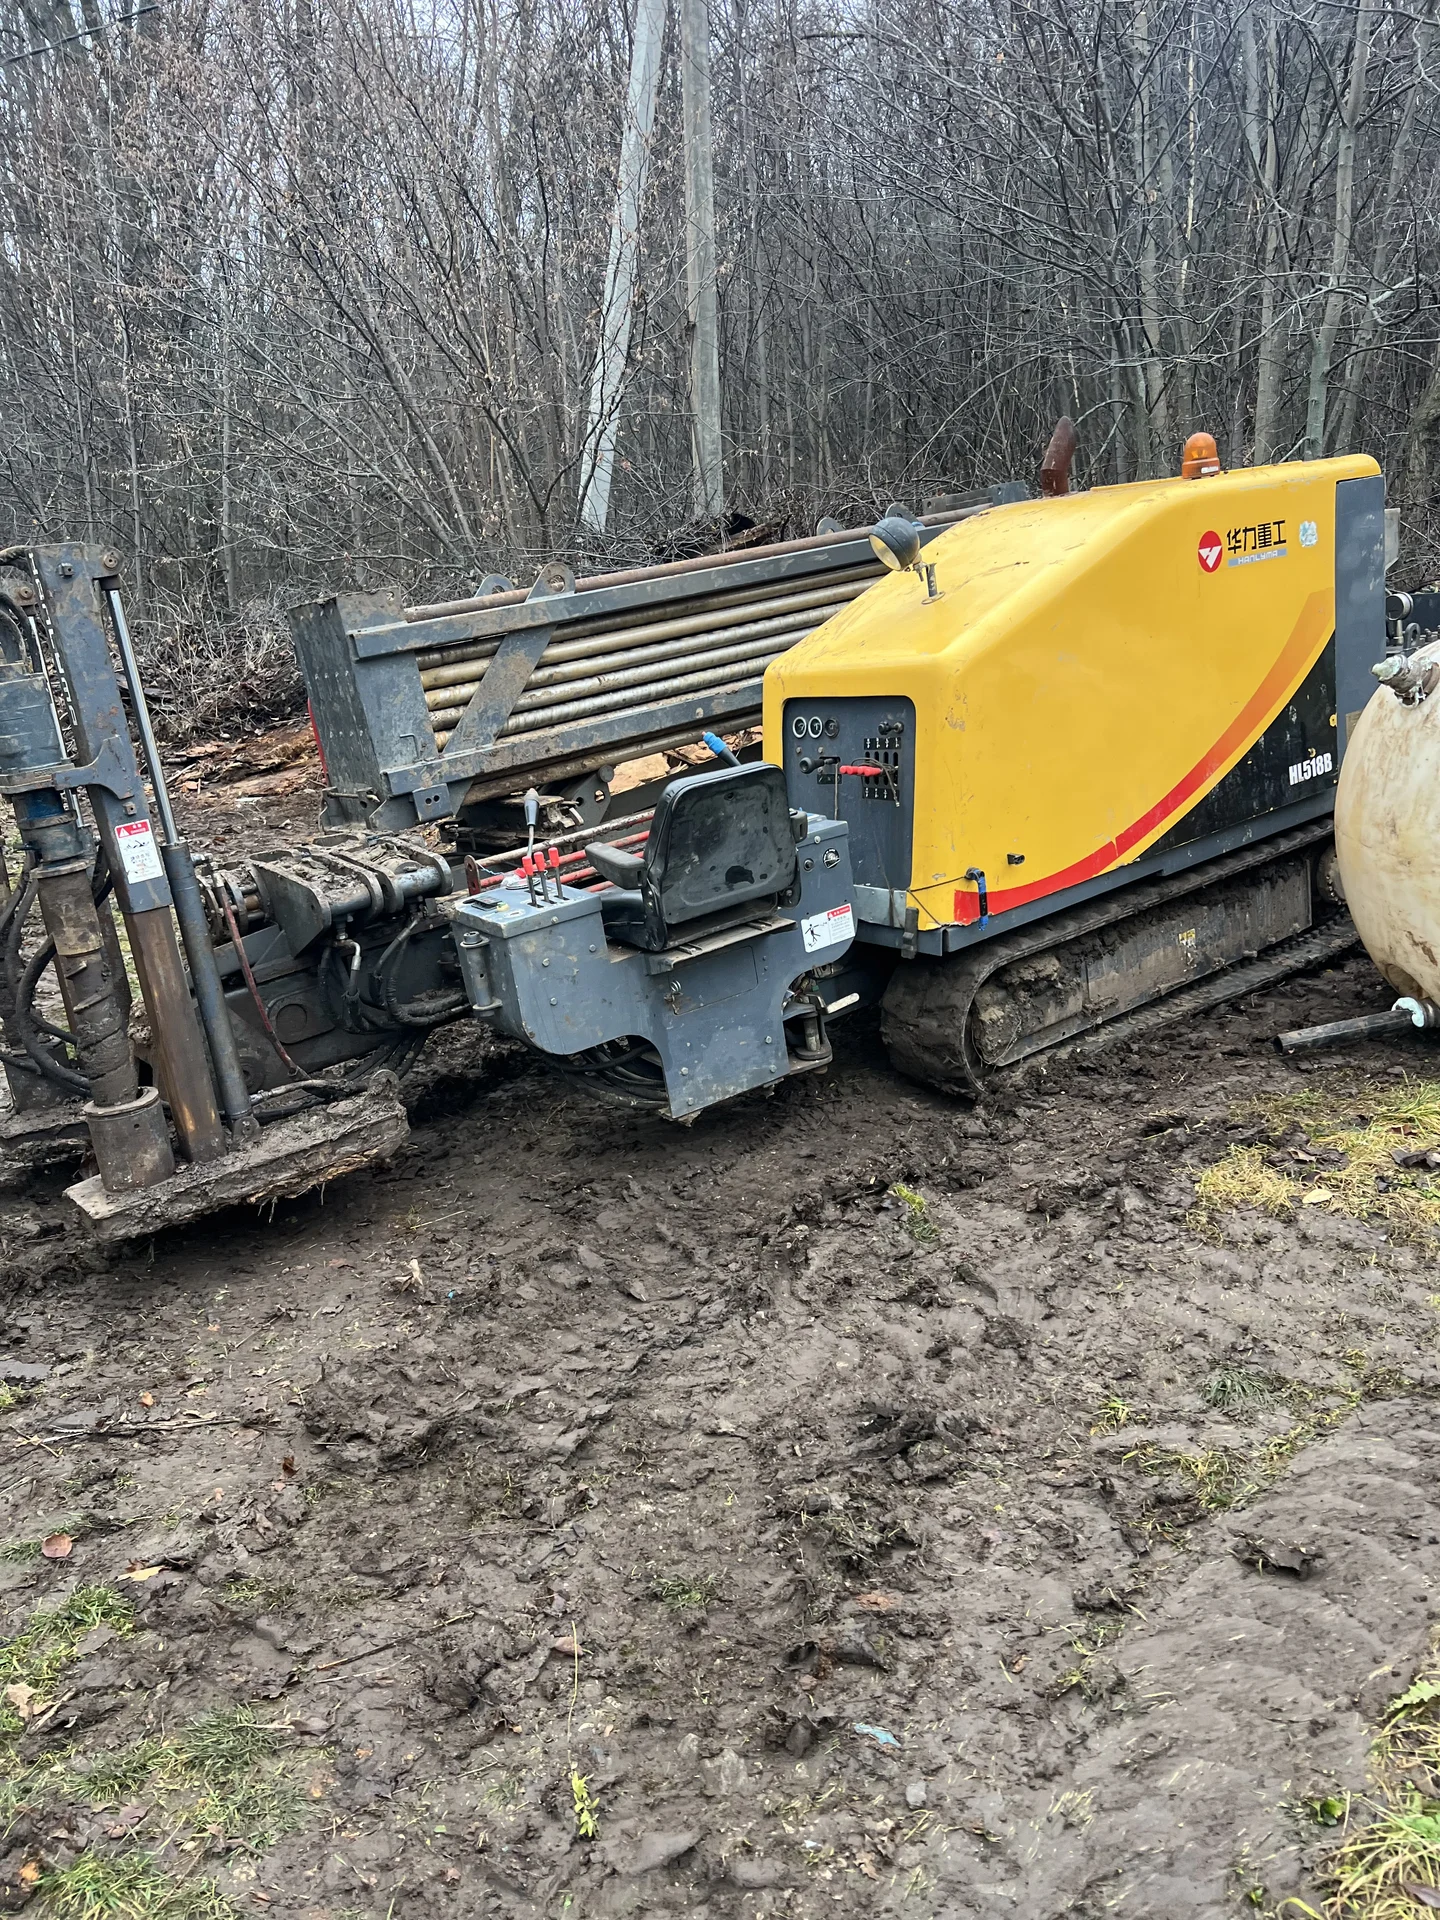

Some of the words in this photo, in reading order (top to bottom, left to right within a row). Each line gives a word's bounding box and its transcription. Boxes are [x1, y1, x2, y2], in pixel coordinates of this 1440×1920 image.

[1226, 519, 1287, 554] 华力重工
[1237, 549, 1278, 565] HANLYMA
[1288, 752, 1333, 786] HL518B
